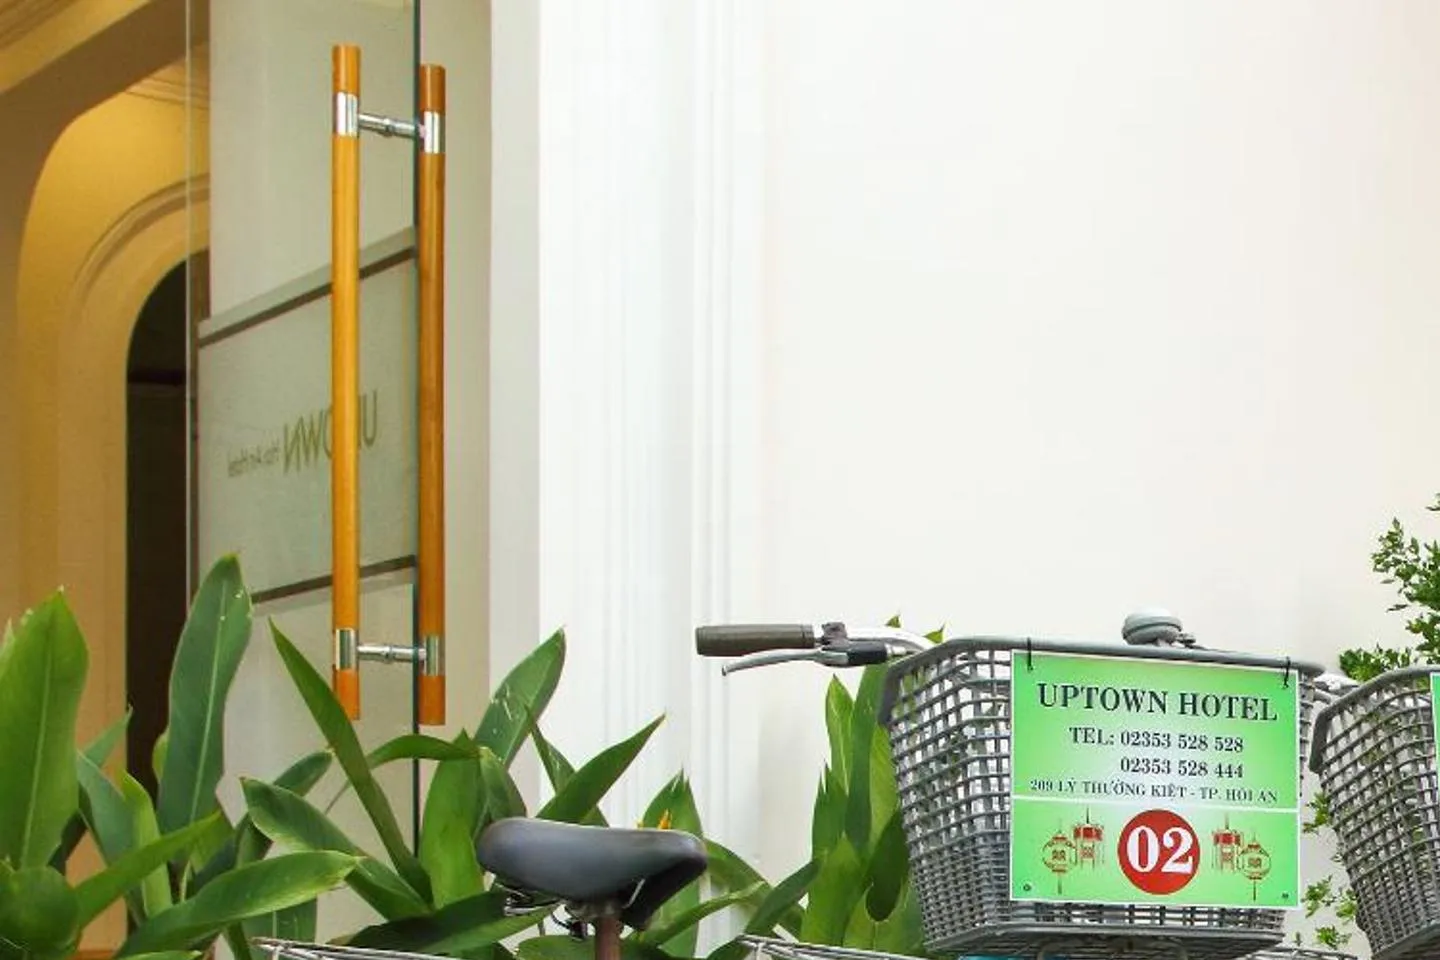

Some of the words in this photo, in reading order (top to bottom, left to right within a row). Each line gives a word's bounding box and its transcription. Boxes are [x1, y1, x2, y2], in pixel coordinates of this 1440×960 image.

[1038, 683, 1169, 714] UPTOWN
[1178, 693, 1277, 721] HOTEL
[1069, 727, 1115, 746] TEL:
[1120, 731, 1171, 749] 02353
[1178, 734, 1208, 751] 528
[1214, 736, 1244, 753] 528
[1120, 758, 1171, 775] 02353
[1178, 760, 1208, 777] 528
[1214, 762, 1244, 778] 444
[1126, 825, 1194, 874] 02
